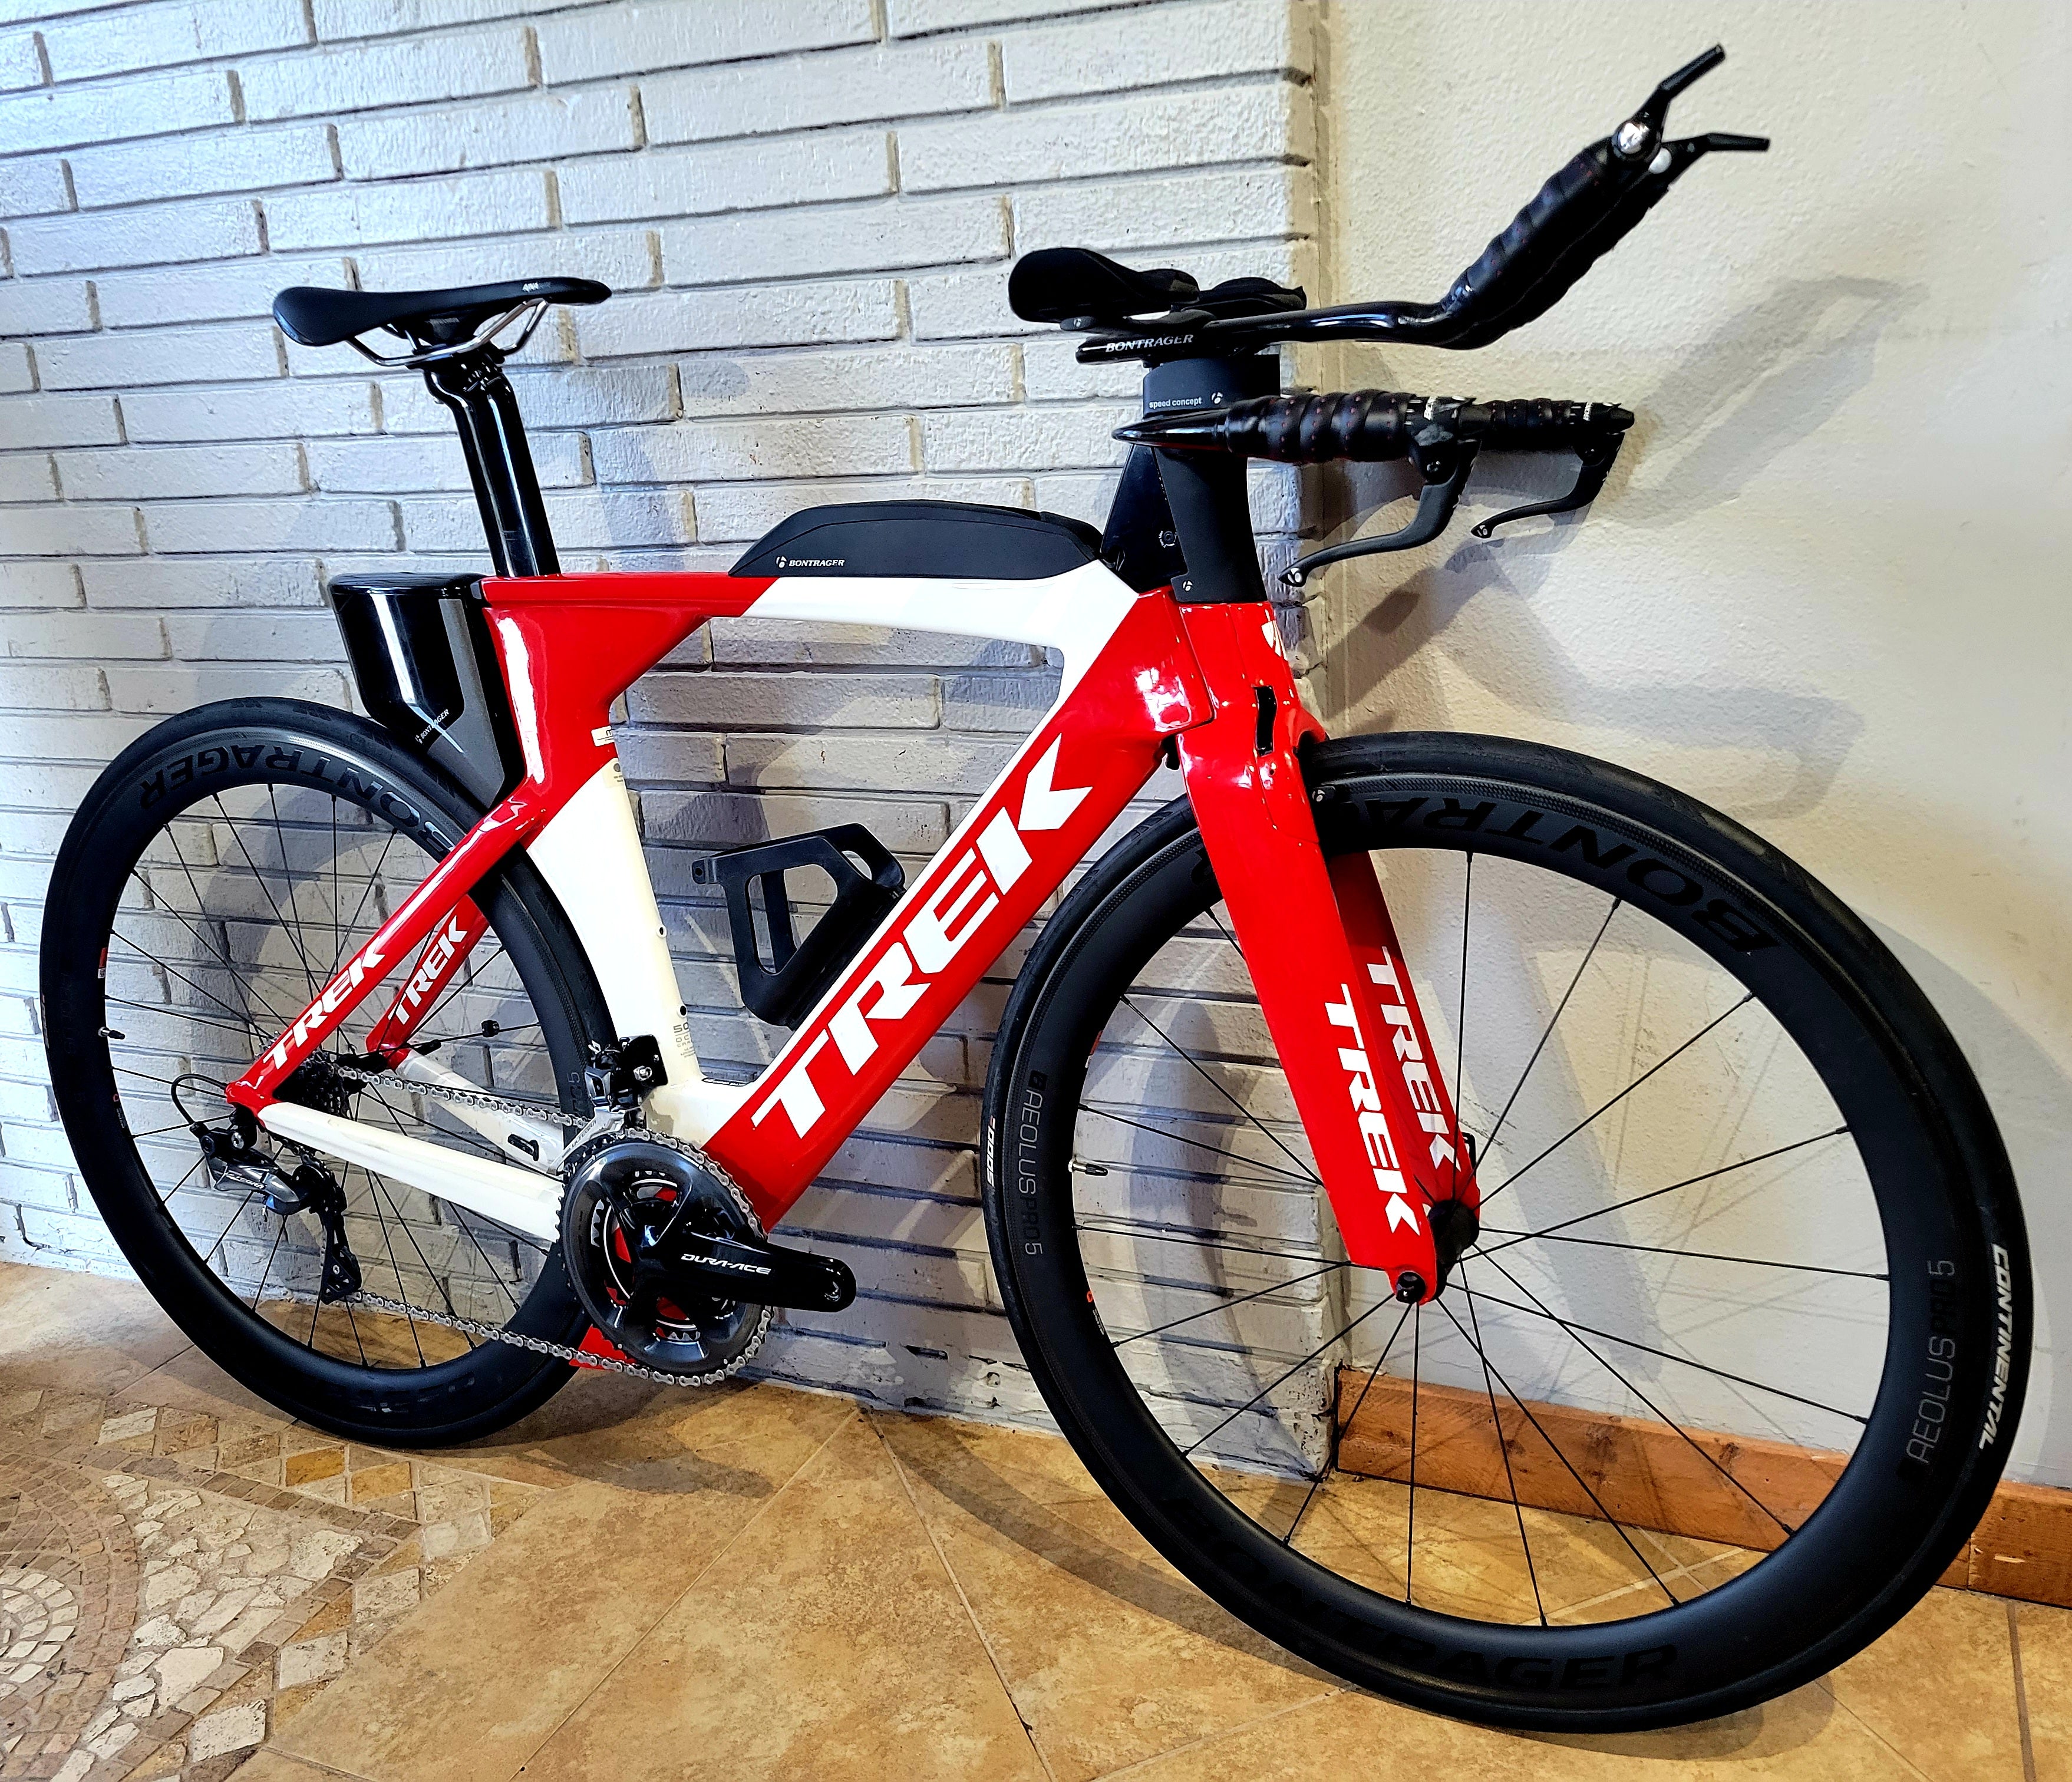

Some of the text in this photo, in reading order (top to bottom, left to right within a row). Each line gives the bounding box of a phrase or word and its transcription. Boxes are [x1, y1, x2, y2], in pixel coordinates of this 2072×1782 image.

[1106, 334, 1194, 352] BONTRAGER
[1149, 397, 1202, 410] speed concept
[139, 744, 454, 856] BONTRAGER
[1354, 796, 1780, 953] BONTRA
[388, 915, 468, 1025] TREK
[751, 732, 1093, 1139] TREK
[263, 946, 386, 1070] TREK
[673, 1022, 689, 1033] 50
[1367, 946, 1461, 1172] TREK
[568, 1072, 580, 1083] 5
[1324, 983, 1420, 1236] TREK
[986, 1125, 995, 1187] 5000
[1018, 1089, 1043, 1195] AEOLUS
[681, 1253, 771, 1275] DURA-ACE
[1026, 1242, 1042, 1255] 5
[1928, 1260, 1956, 1276] 5
[1905, 1335, 1956, 1464] AEOLUS
[1978, 1243, 2013, 1450] CONTINENTAL
